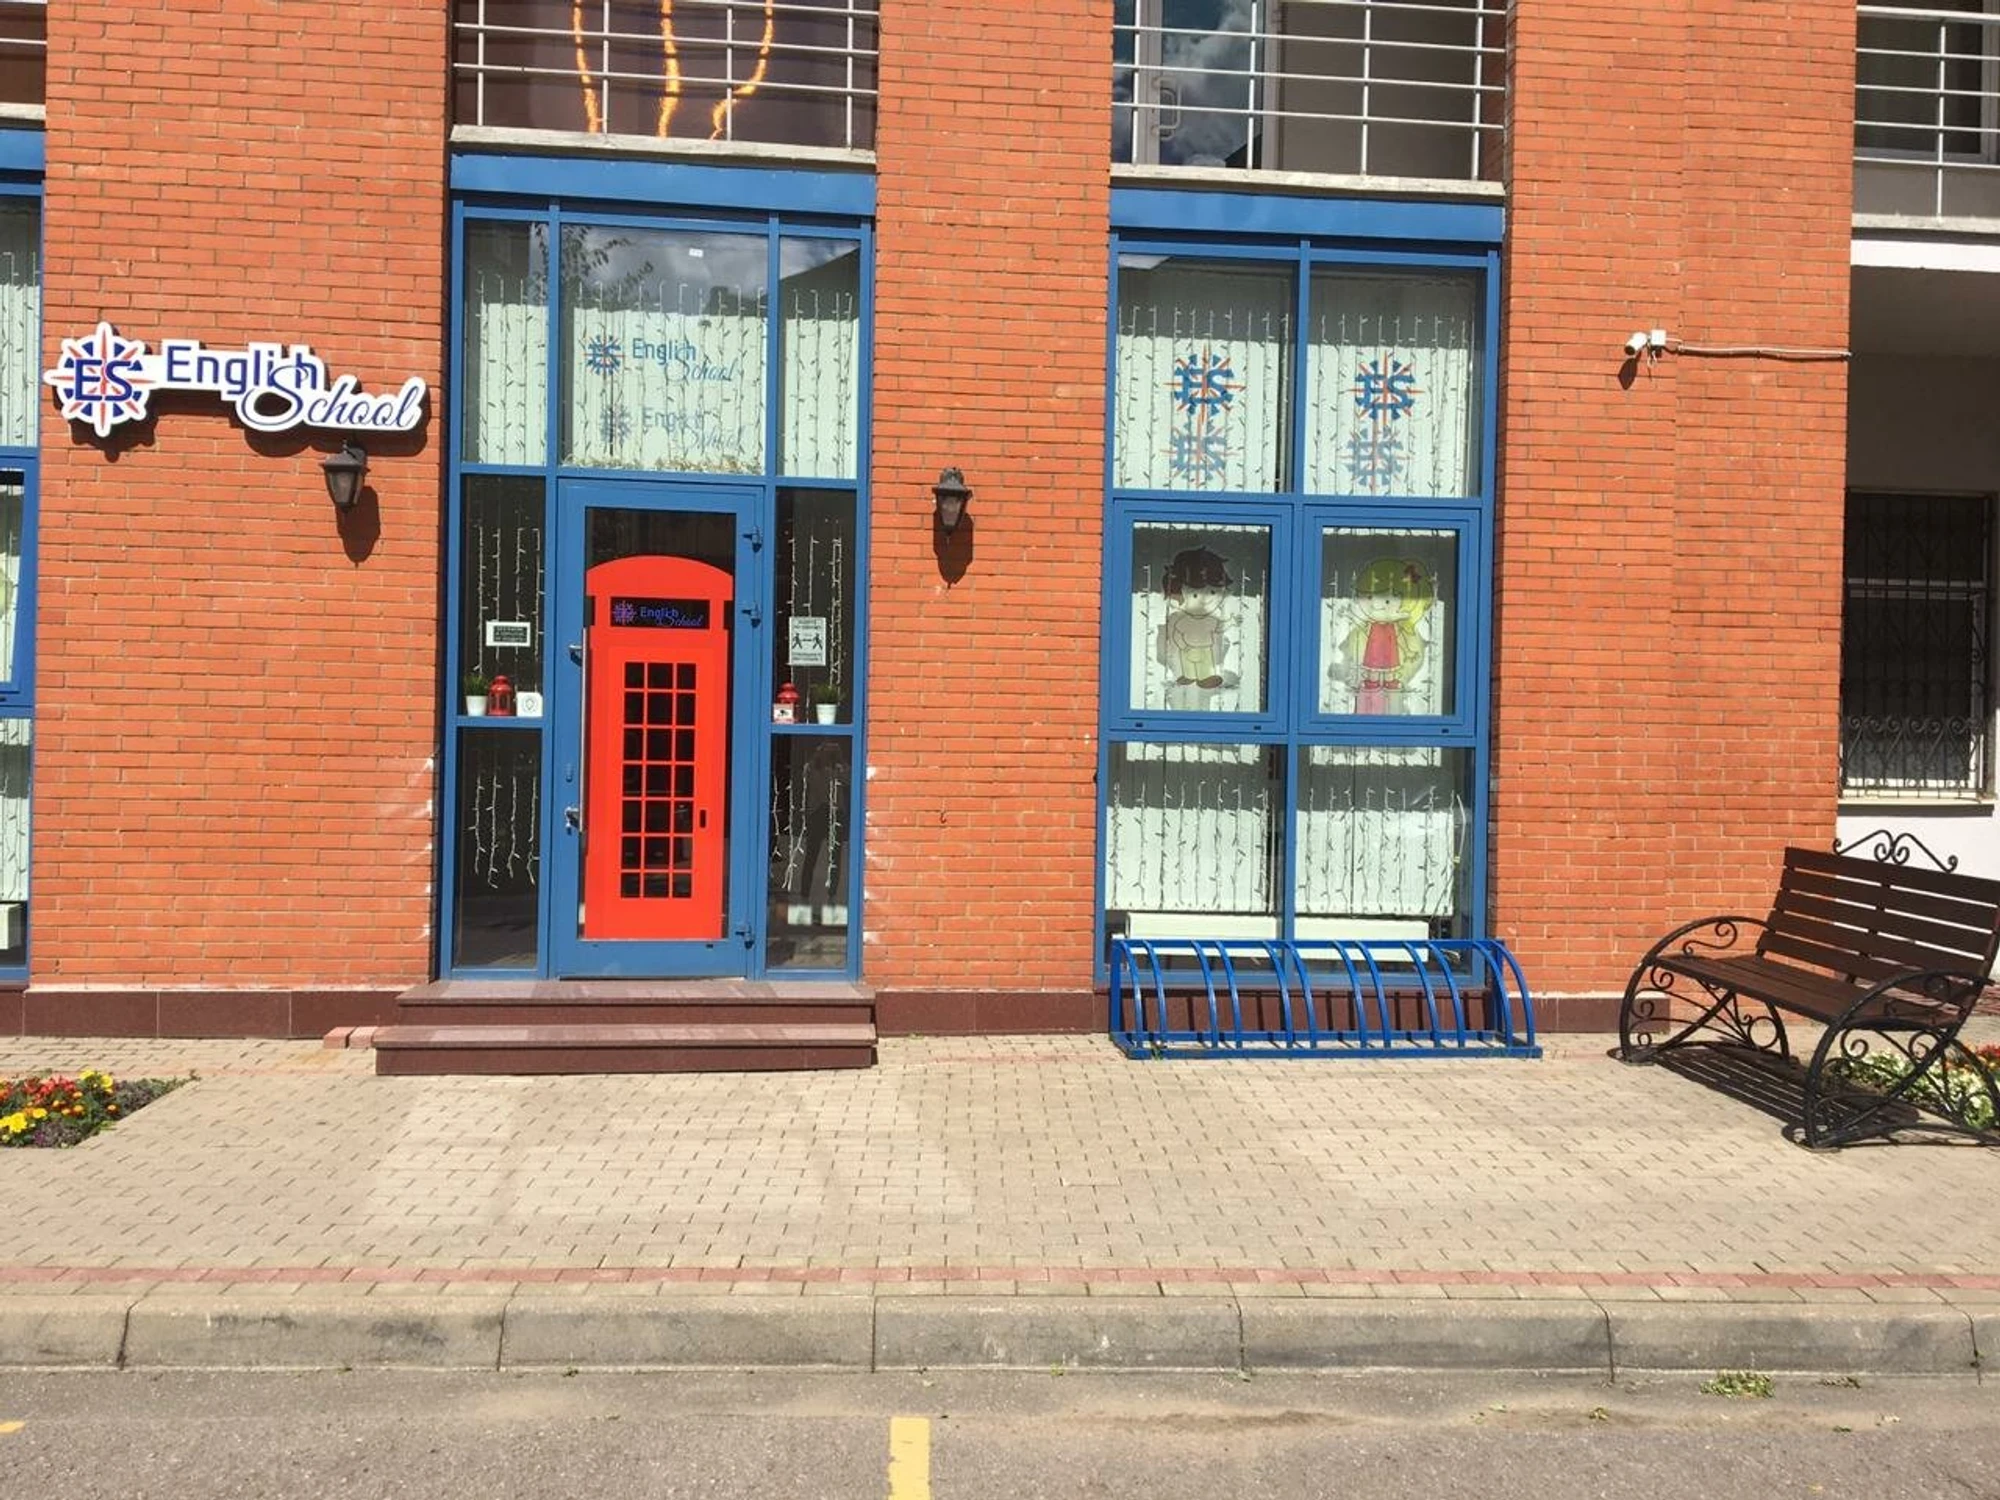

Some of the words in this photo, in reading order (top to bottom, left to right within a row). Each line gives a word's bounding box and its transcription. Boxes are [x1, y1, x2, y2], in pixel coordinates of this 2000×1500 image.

[74, 359, 133, 402] ES
[666, 348, 739, 382] School
[241, 365, 420, 426] School
[1182, 368, 1232, 403] ES
[1363, 374, 1413, 408] ES
